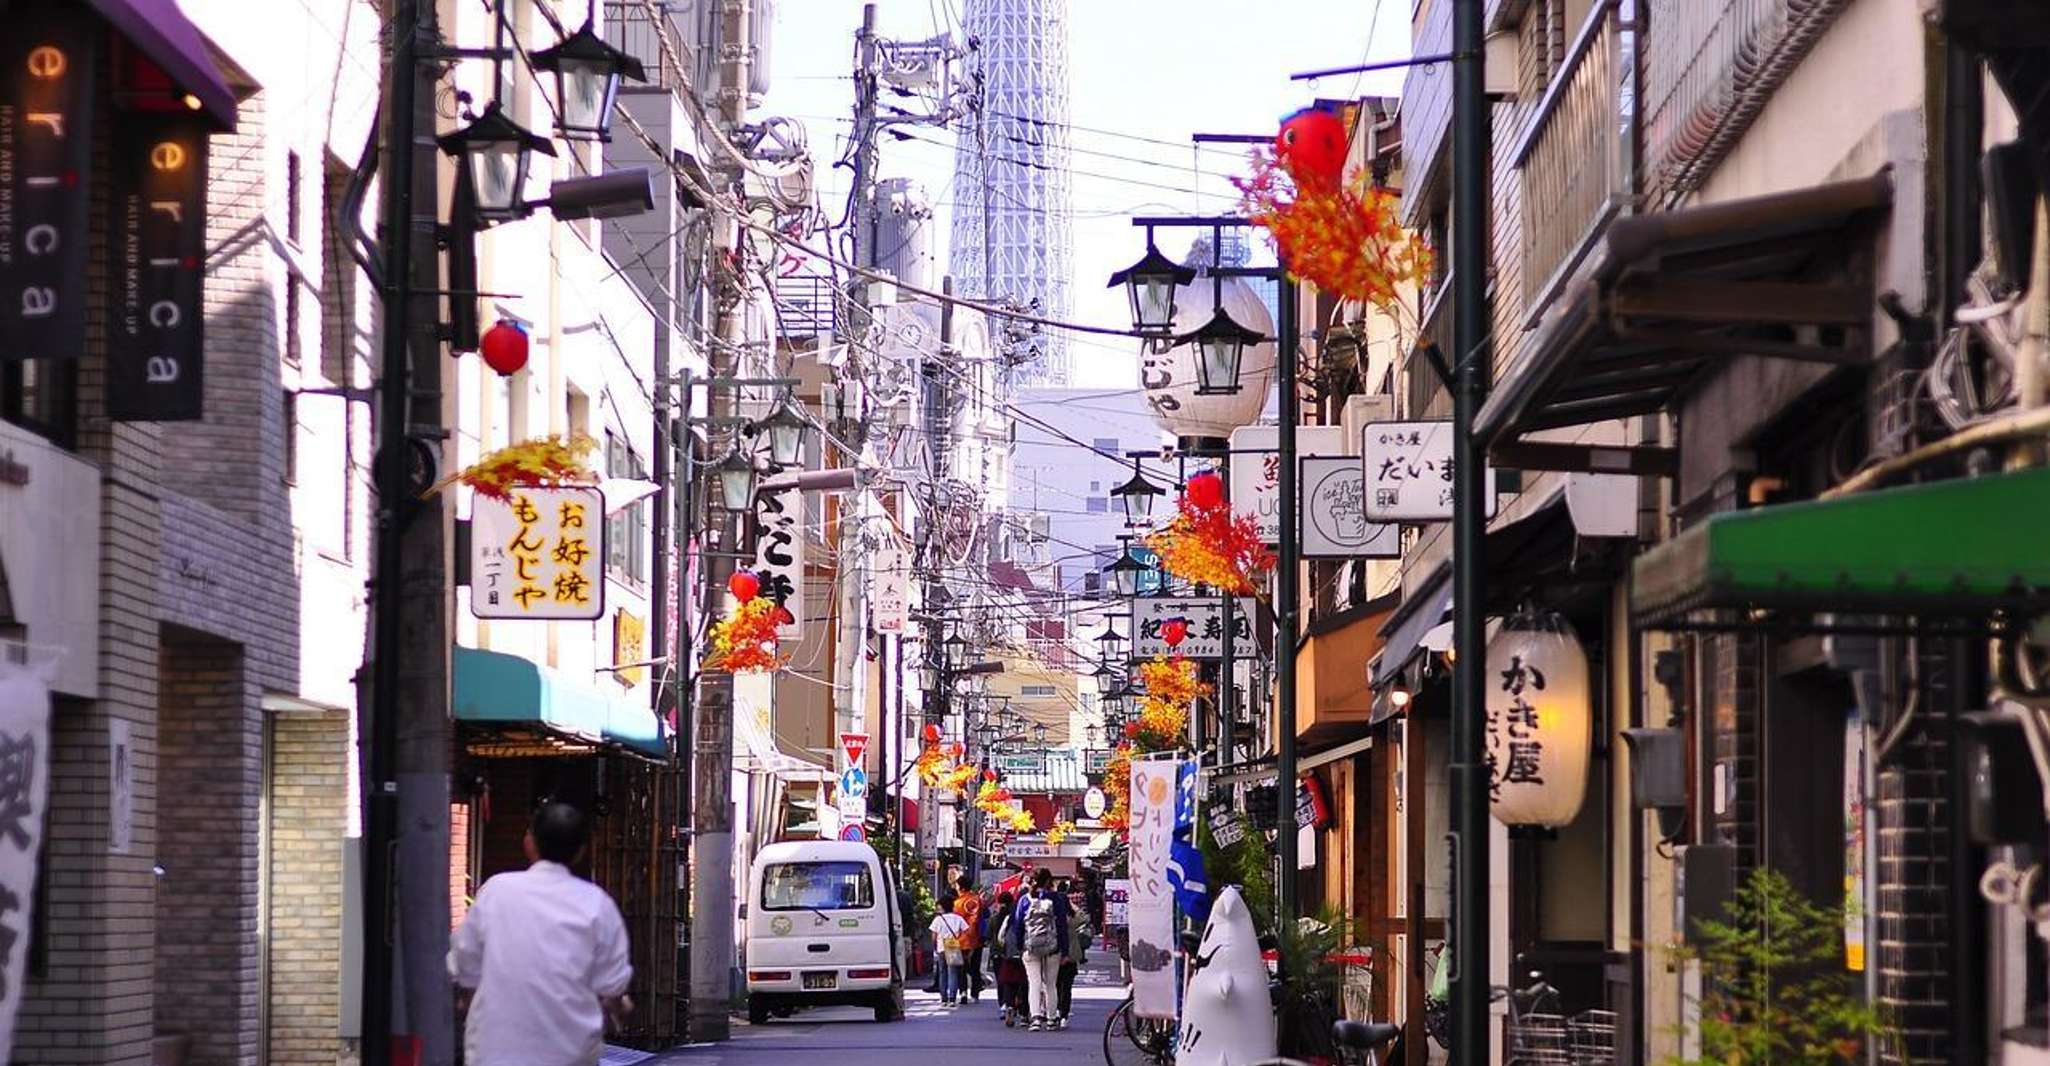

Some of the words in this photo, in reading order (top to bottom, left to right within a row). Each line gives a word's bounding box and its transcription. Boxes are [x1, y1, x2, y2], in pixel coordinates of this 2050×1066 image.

[0, 150, 13, 183] AND
[23, 45, 77, 316] erica
[126, 234, 138, 263] AND
[147, 141, 196, 383] erica
[1378, 455, 1455, 482] だいま
[1379, 431, 1421, 447] かき屋
[552, 501, 589, 603] お好焼
[1501, 655, 1547, 786] かき屋
